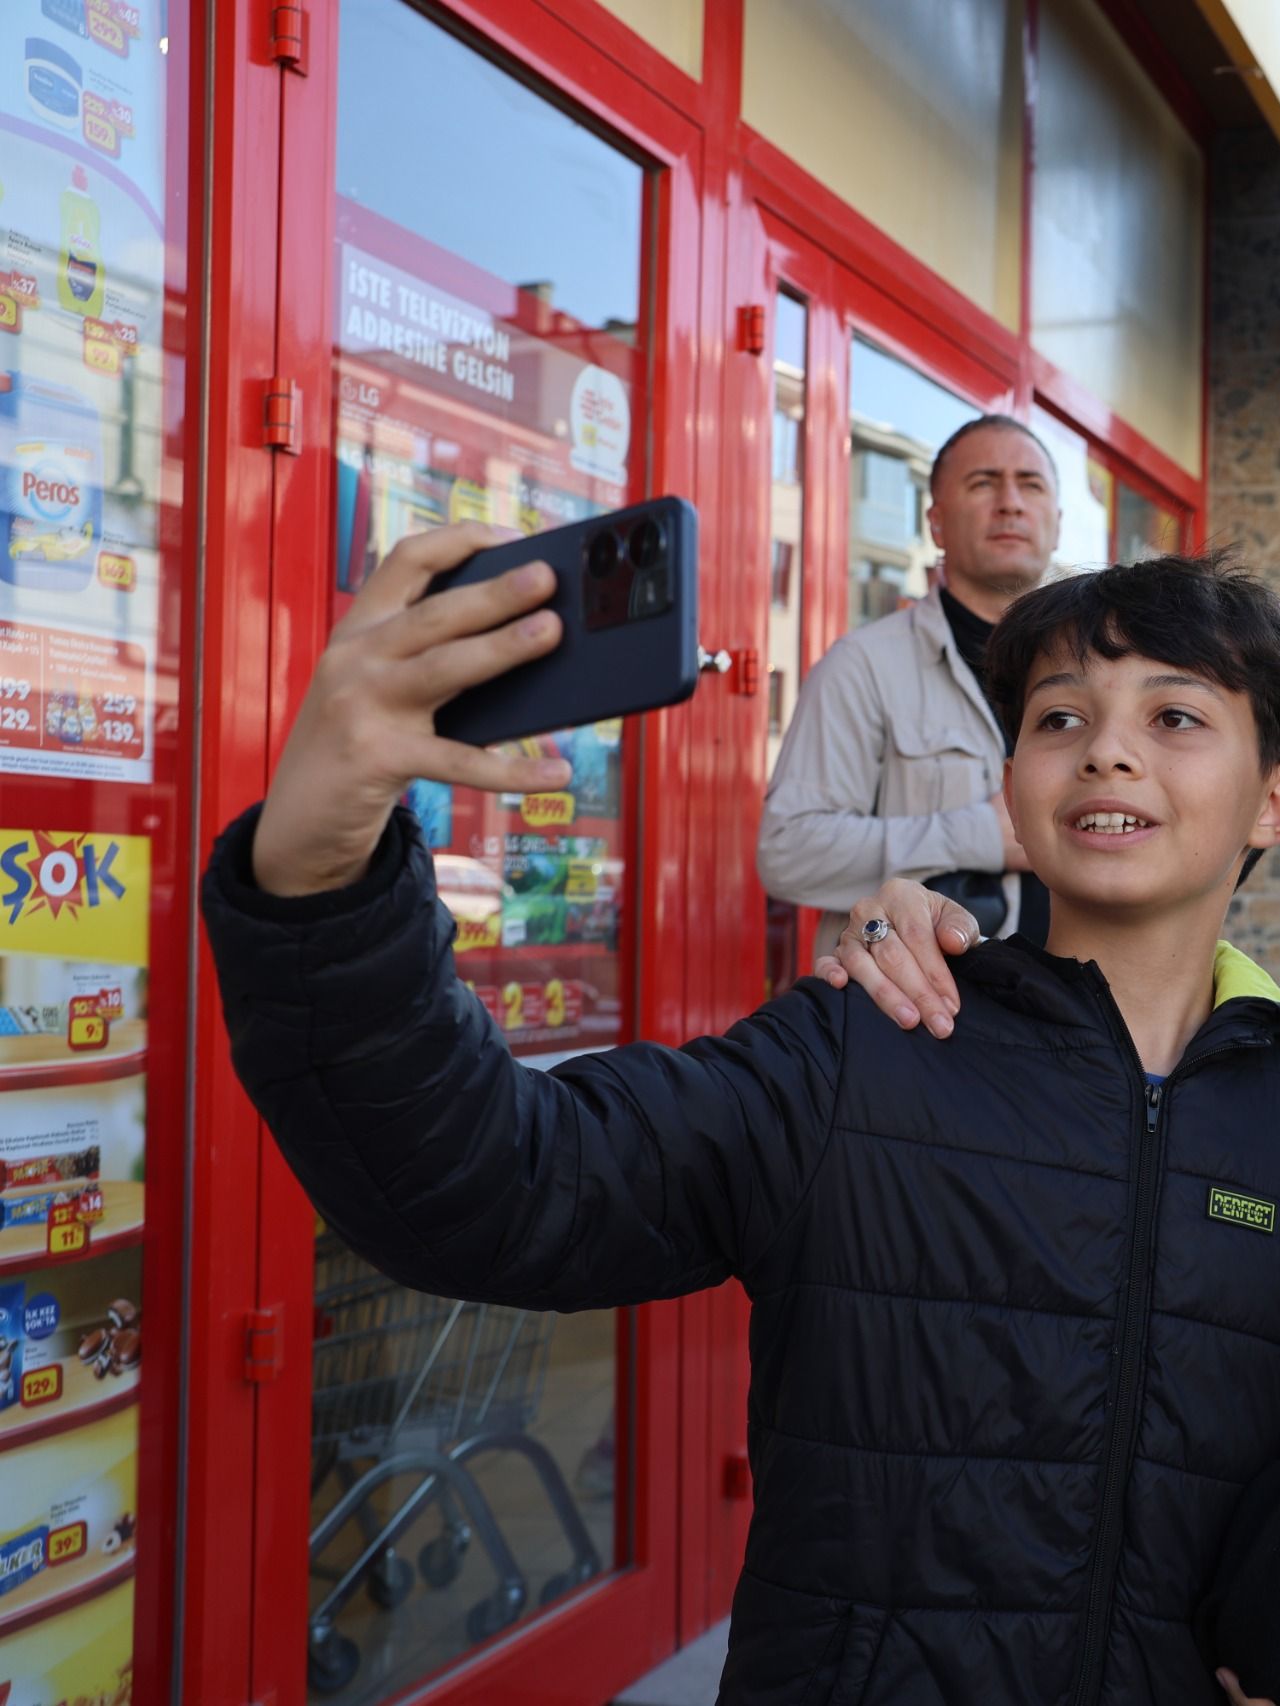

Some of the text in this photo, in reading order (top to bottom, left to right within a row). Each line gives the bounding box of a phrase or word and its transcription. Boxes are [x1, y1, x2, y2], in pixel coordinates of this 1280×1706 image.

[399, 286, 510, 363] TELEVİZYON
[347, 305, 514, 402] ADRESİNE GELSİN
[358, 384, 380, 406] LG
[22, 472, 80, 506] Peros
[103, 719, 134, 743] 139
[0, 840, 127, 925] ŞOK
[1213, 1193, 1272, 1226] PERFECT
[25, 1377, 51, 1397] 129
